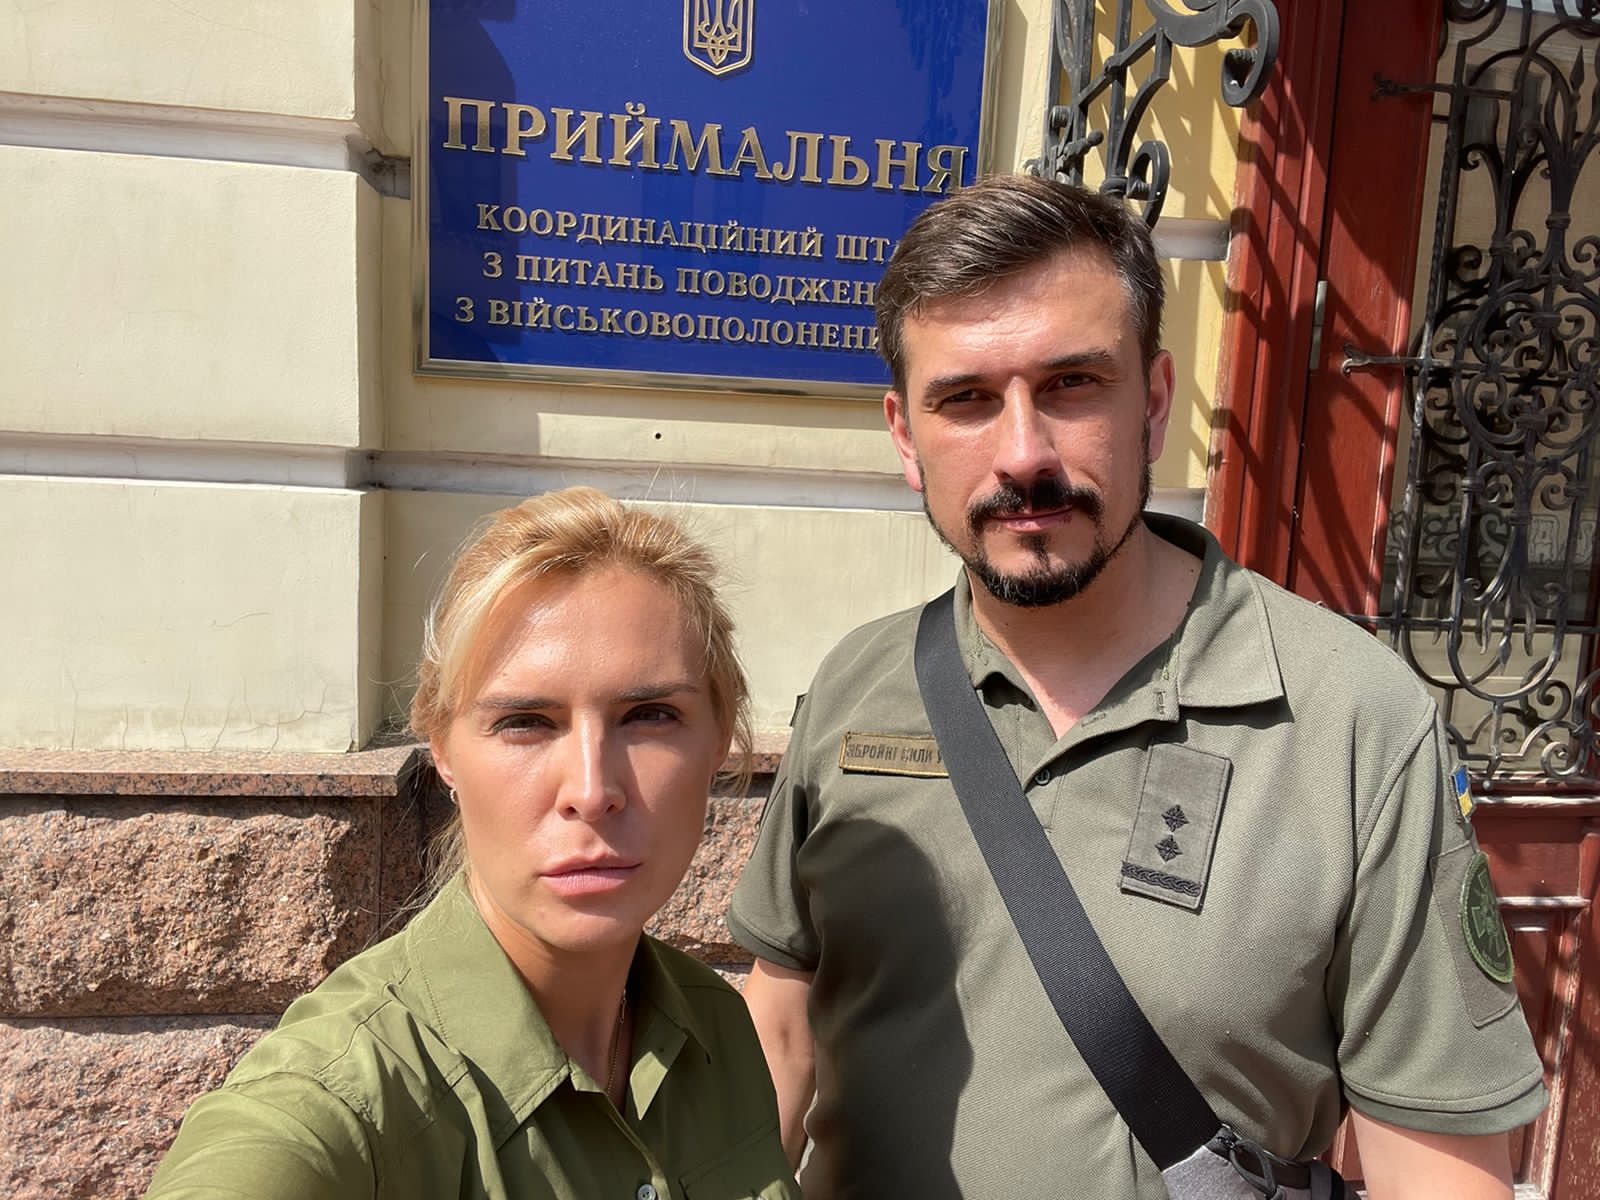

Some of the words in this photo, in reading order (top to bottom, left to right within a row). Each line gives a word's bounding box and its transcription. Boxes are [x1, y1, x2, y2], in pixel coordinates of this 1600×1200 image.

[443, 96, 968, 194] ПРИЙМАЛЬНЯ
[476, 203, 824, 258] КООРДИНАЦІЙНИЙ
[482, 252, 503, 278] З
[515, 254, 664, 290] ПИТАНЬ
[455, 296, 475, 323] З
